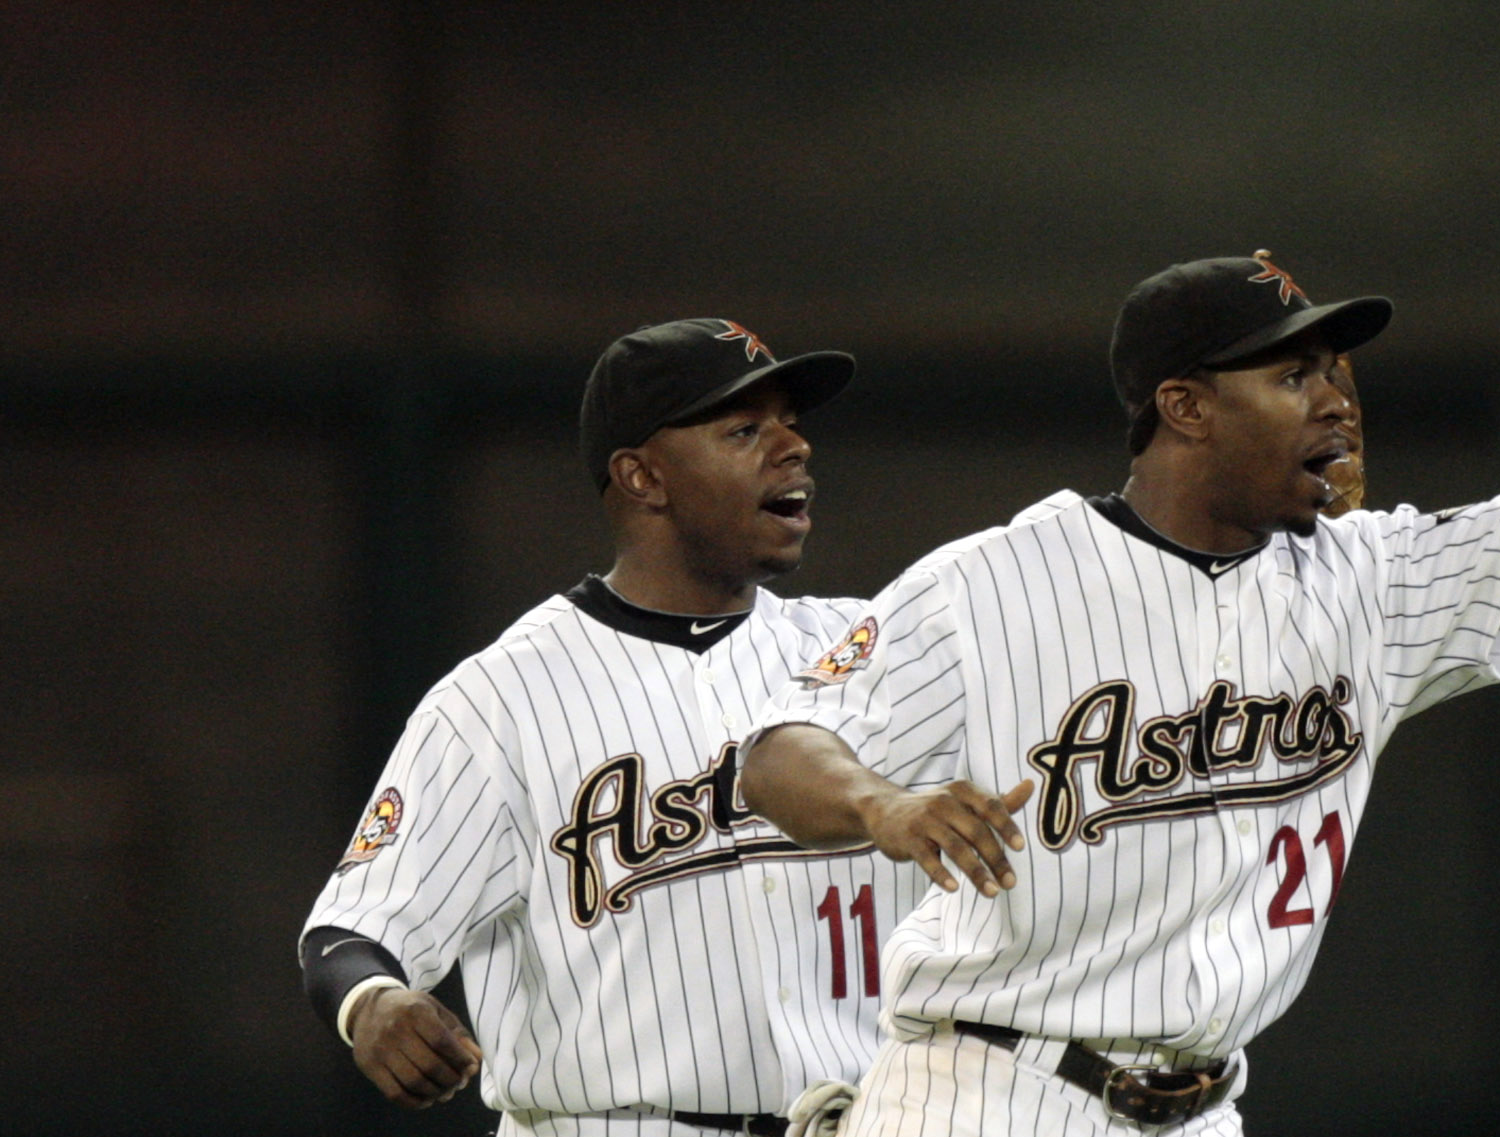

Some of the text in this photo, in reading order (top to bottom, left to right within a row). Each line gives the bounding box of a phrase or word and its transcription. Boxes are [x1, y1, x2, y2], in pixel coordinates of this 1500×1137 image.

[550, 741, 765, 930] Ast
[1026, 674, 1363, 853] Astros
[816, 883, 881, 1000] 11
[1265, 809, 1346, 931] 21
